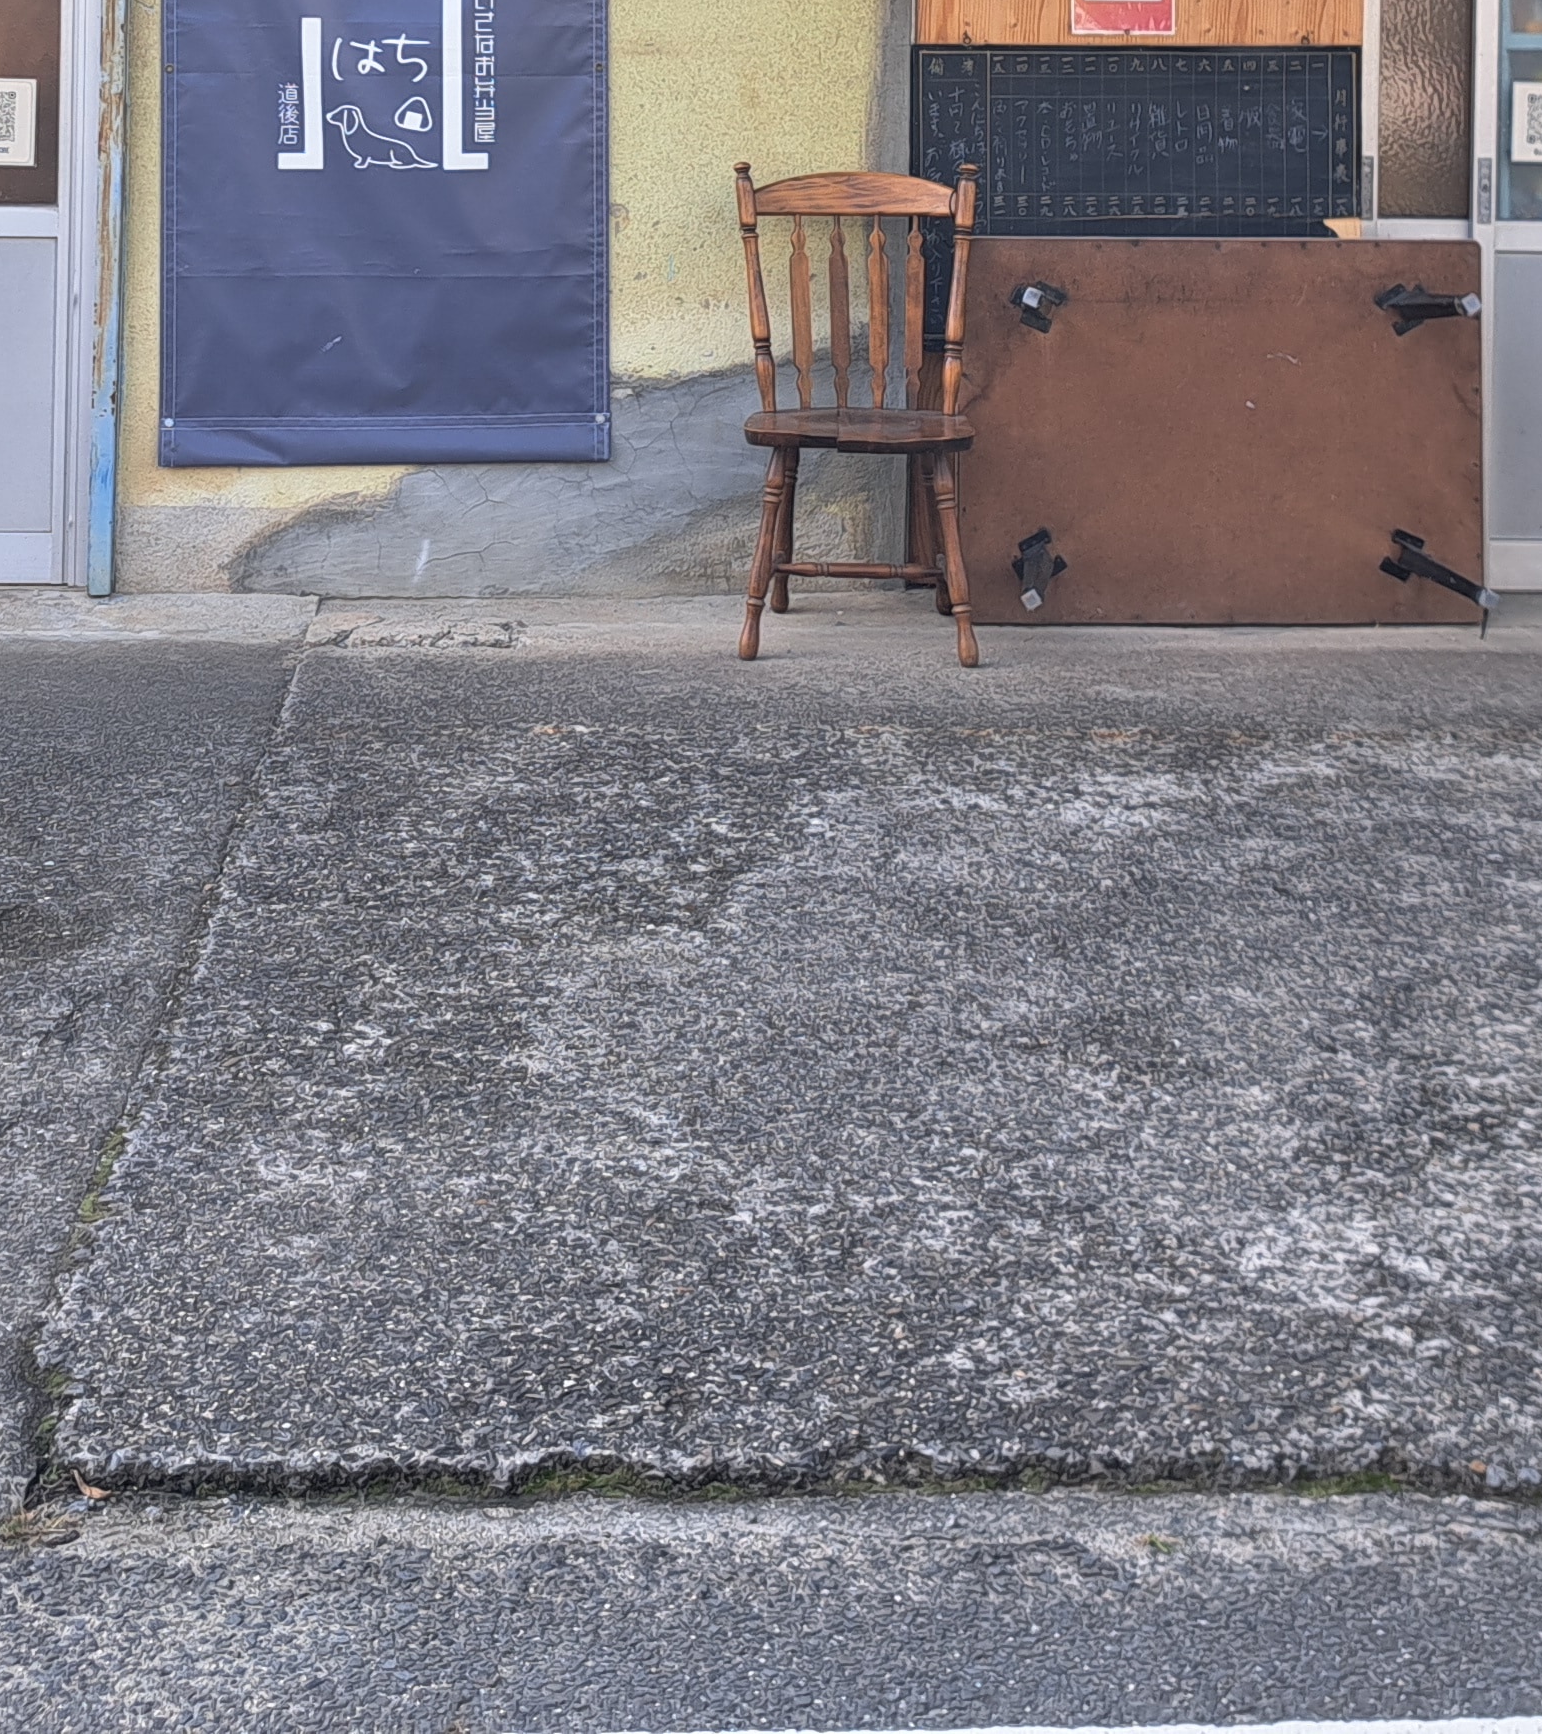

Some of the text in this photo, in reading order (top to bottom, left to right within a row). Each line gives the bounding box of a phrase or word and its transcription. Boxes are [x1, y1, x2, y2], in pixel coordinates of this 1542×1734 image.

[331, 33, 431, 83] はち
[277, 82, 300, 146] 道後店
[1106, 102, 1124, 161] リユース
[1128, 104, 1144, 176] リサイクル
[1174, 101, 1189, 152] レトロ
